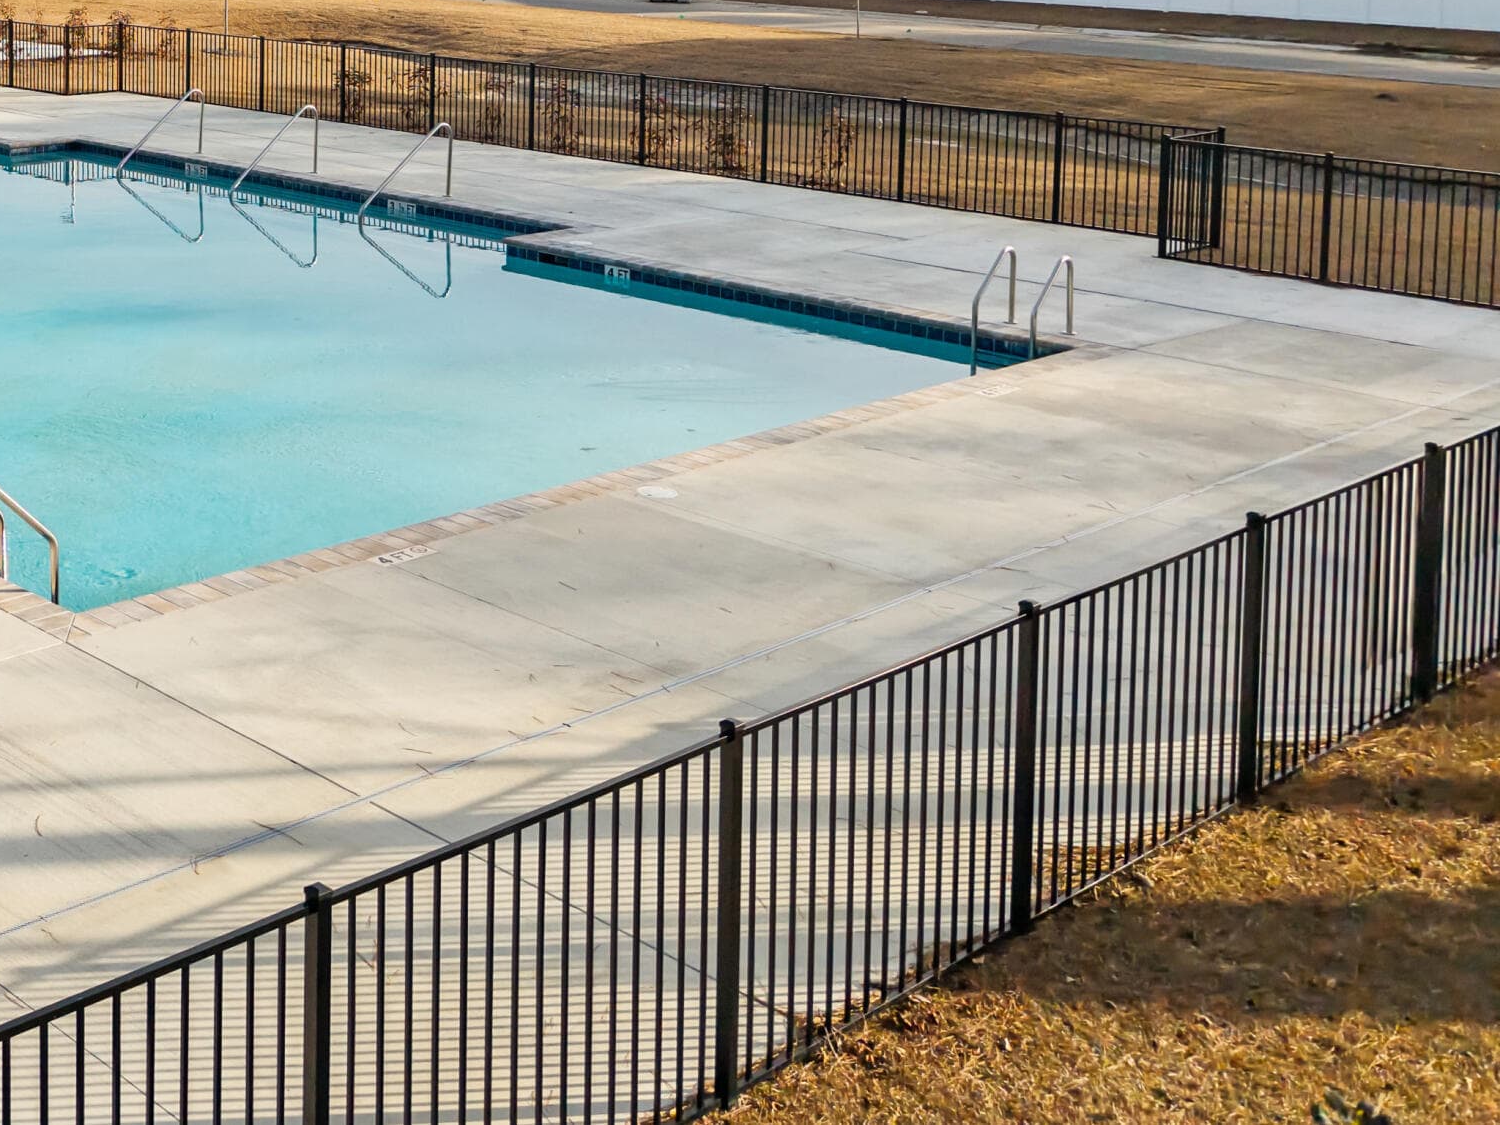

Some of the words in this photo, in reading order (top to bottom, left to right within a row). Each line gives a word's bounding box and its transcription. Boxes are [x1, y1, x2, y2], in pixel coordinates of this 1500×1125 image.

[607, 267, 614, 276] 4
[378, 556, 394, 564] 4
[389, 551, 414, 561] FT
